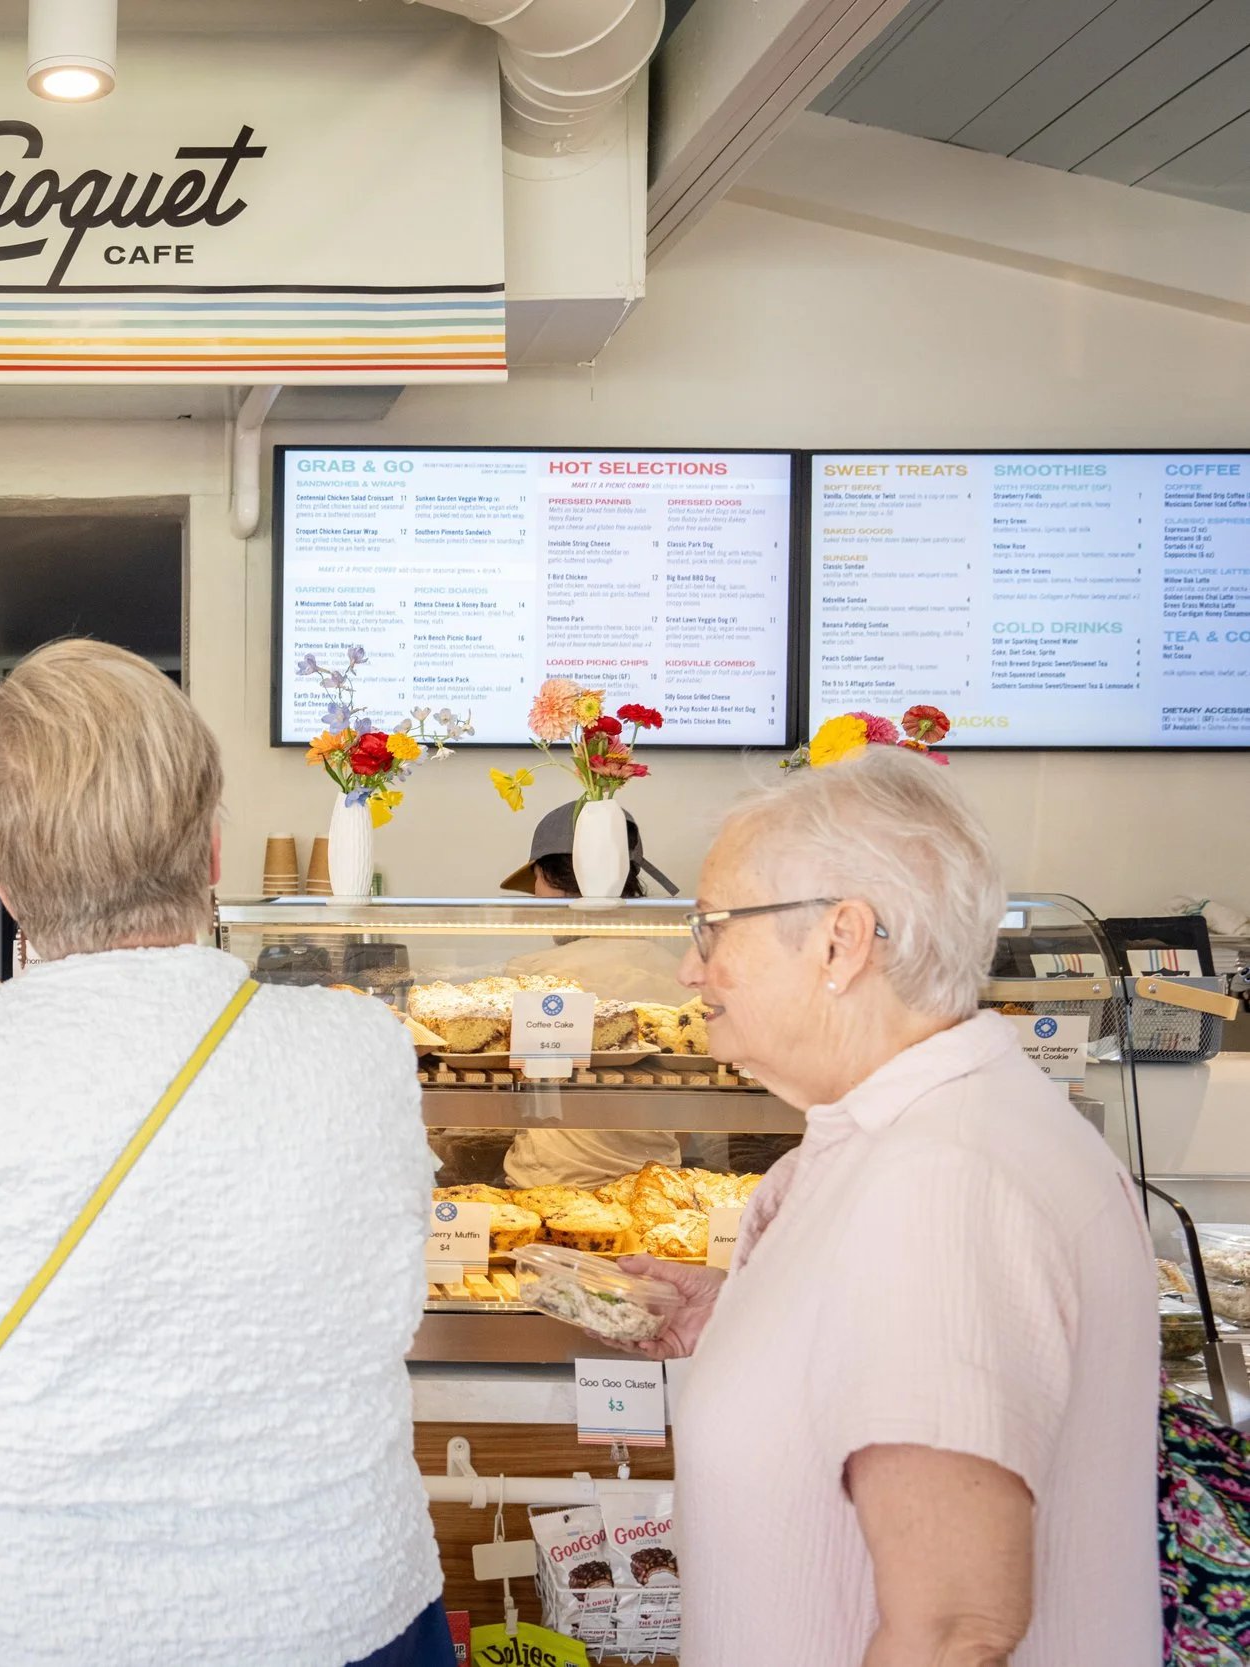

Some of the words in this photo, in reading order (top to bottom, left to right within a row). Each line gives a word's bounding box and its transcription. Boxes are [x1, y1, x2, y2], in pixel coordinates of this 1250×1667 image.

[104, 245, 194, 264] CAFE
[297, 460, 356, 472] GRAB
[362, 460, 376, 472] &
[384, 460, 414, 473] GO
[550, 462, 592, 474] HOT
[600, 462, 727, 475] SELECTIONS
[824, 464, 888, 476] SWEET
[899, 464, 968, 476] TREATS
[994, 464, 1107, 476] SMOOTHIES
[1166, 464, 1241, 476] COFFEE
[993, 622, 1046, 633] COLD
[1051, 622, 1123, 634] DRINKS
[1166, 631, 1200, 642] TEA
[1206, 631, 1218, 642] &
[526, 1021, 551, 1029] Coffee
[540, 1042, 561, 1050] $4.50
[580, 1378, 599, 1388] Goo
[602, 1379, 621, 1388] Goo
[625, 1379, 656, 1390] Cluster
[608, 1397, 624, 1412] $3
[572, 1552, 598, 1561] CLUSTER
